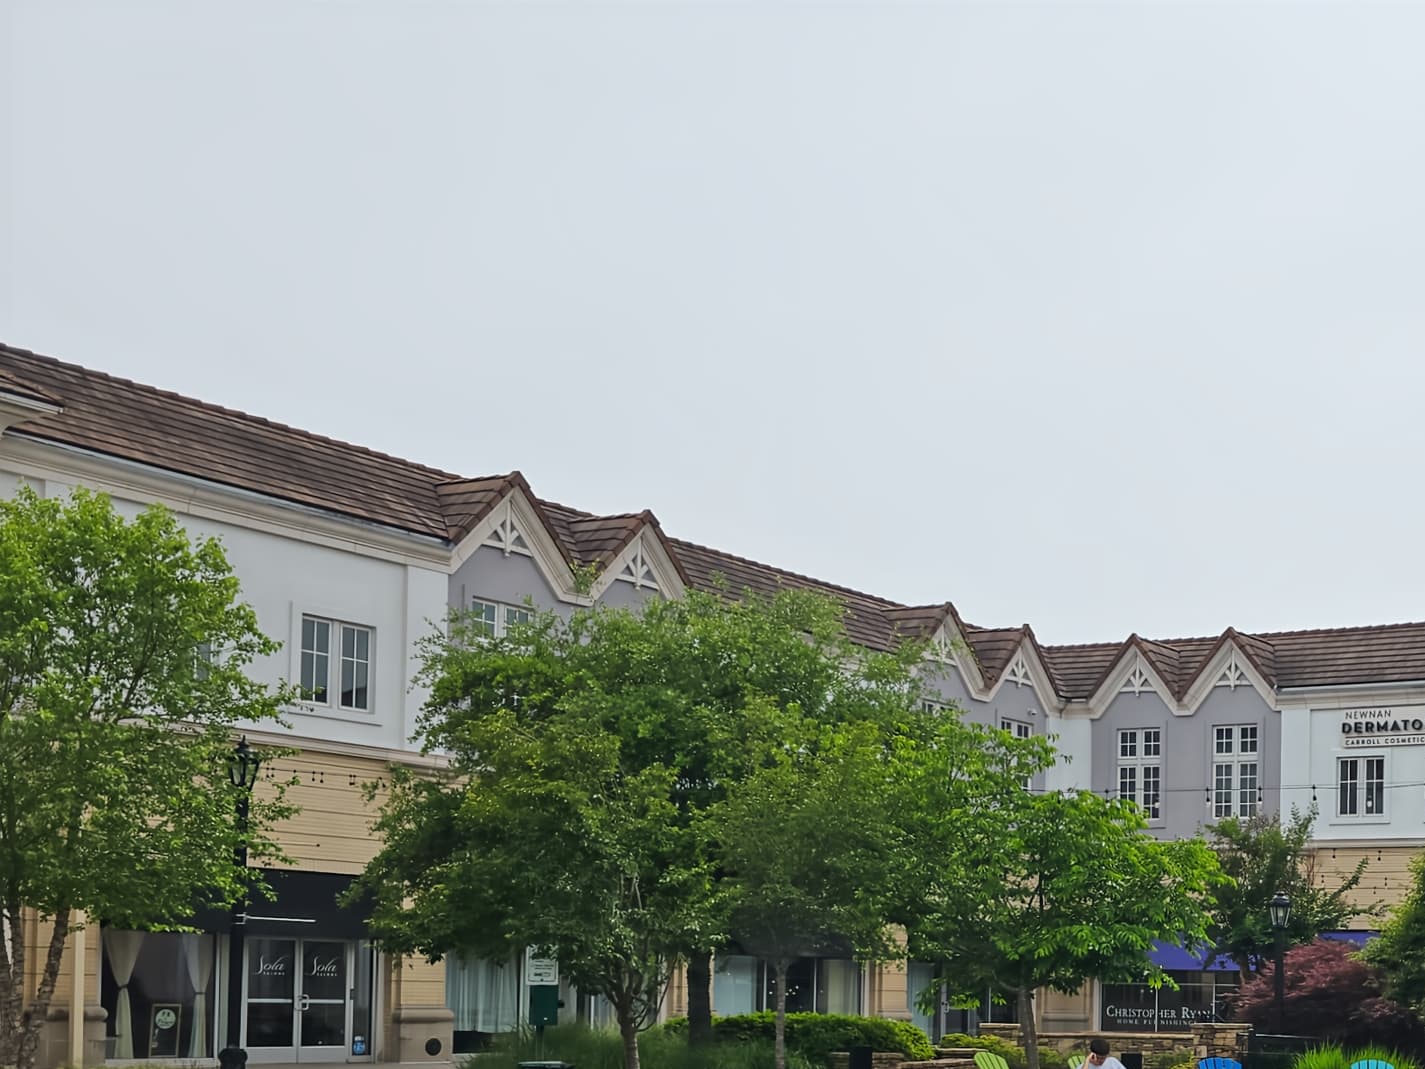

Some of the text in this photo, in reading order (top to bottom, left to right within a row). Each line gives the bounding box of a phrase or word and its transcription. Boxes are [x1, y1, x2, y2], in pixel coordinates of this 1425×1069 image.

[1345, 709, 1391, 720] NEWNAN
[1345, 738, 1381, 746] CARROLL
[1384, 736, 1425, 745] COSMETIC
